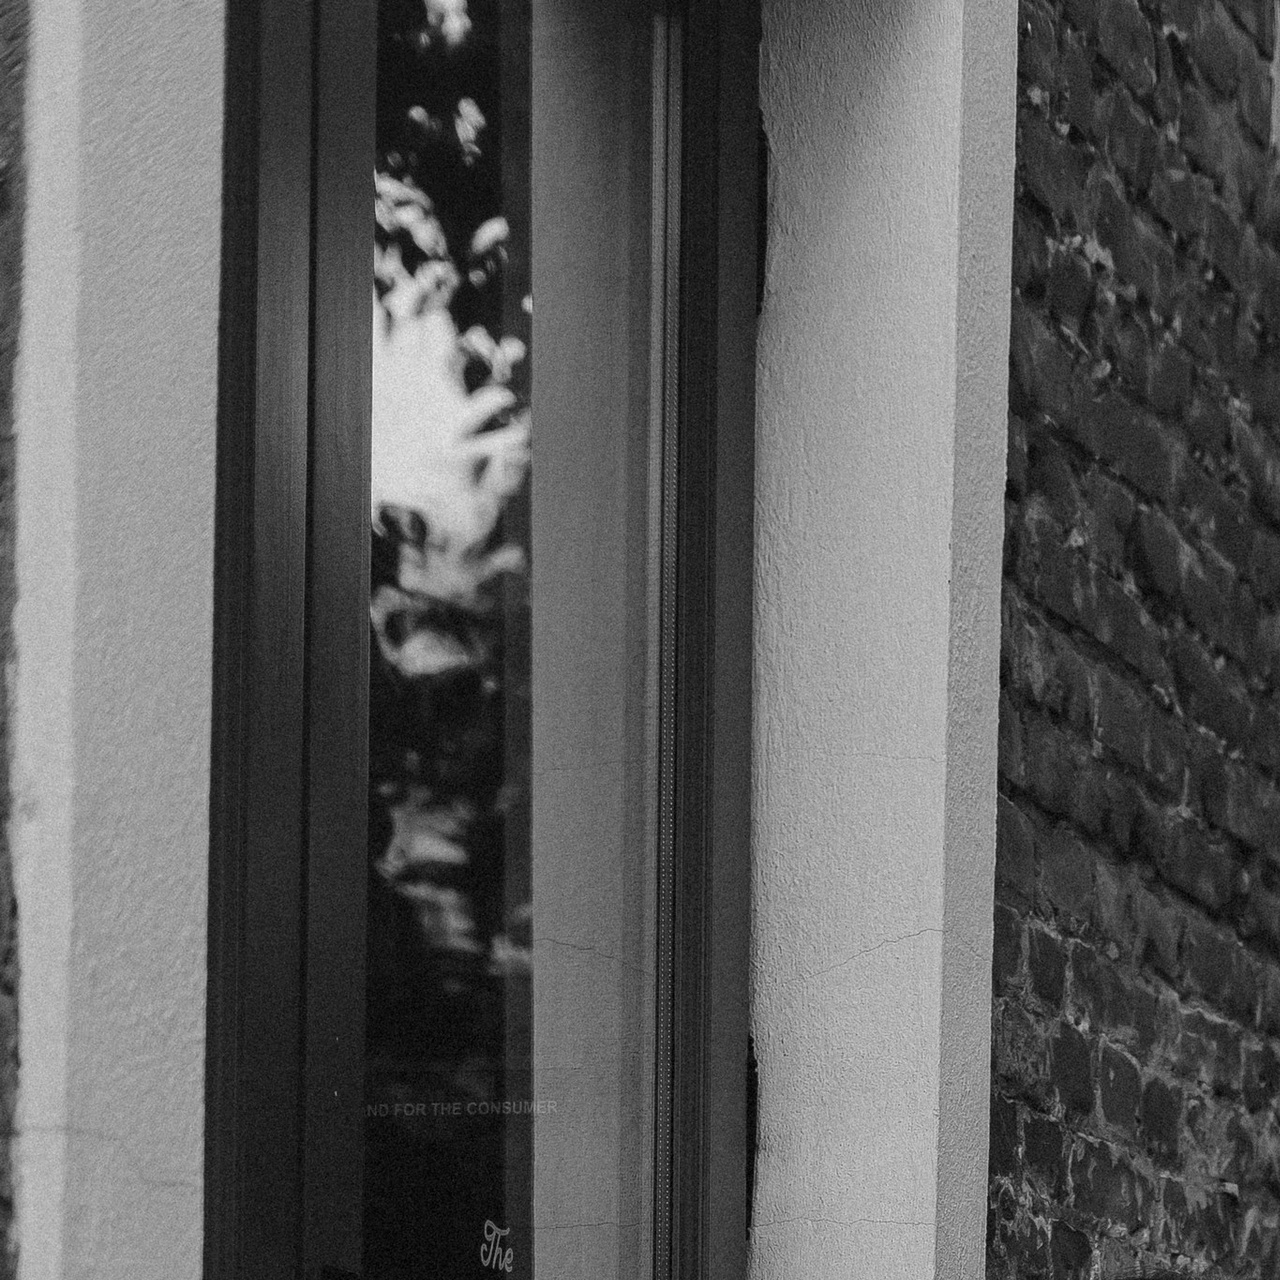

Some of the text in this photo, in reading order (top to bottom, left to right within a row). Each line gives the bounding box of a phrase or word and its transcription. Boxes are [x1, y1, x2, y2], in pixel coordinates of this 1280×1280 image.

[393, 1102, 427, 1117] FOR
[431, 1102, 462, 1116] THE
[466, 1100, 558, 1116] CONSUMER
[480, 1219, 515, 1273] The
